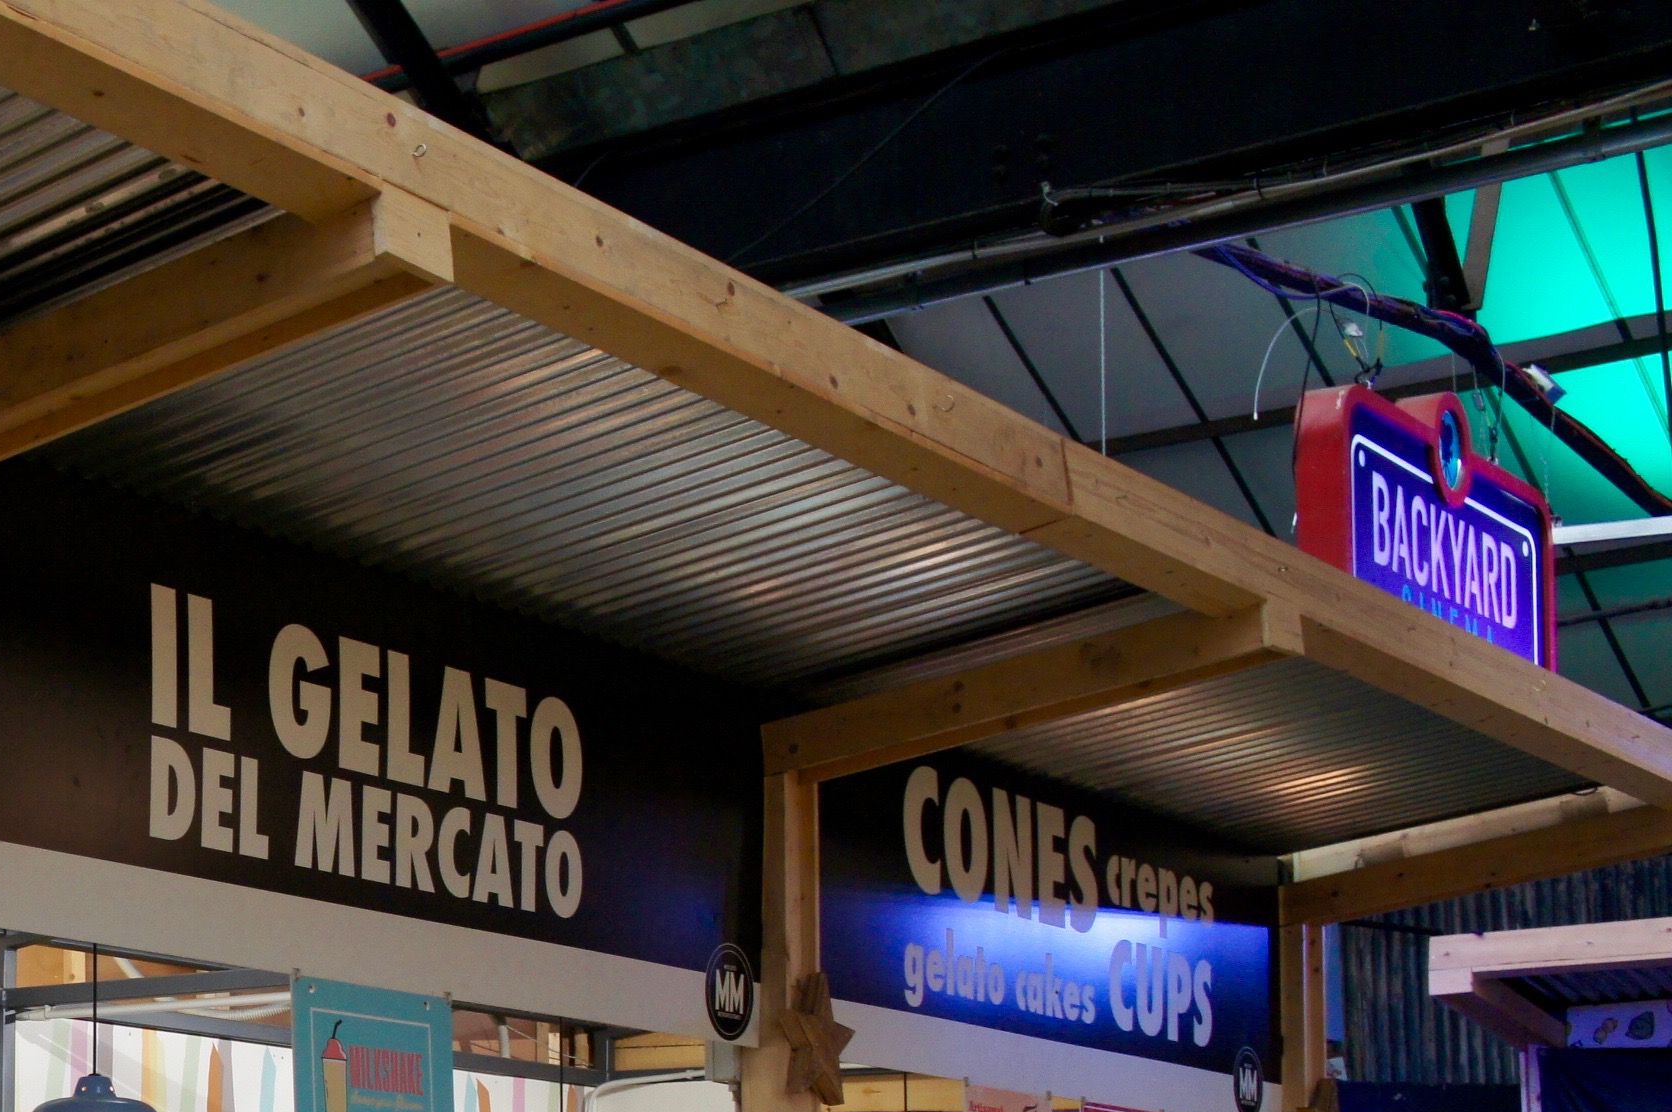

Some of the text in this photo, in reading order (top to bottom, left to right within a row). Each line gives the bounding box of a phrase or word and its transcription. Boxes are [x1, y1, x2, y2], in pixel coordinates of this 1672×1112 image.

[1372, 471, 1517, 629] BACKYARD
[151, 582, 583, 820] IL GELATO
[149, 735, 583, 918] DEL MERCATO
[903, 765, 1214, 939] CONES crepes
[715, 968, 744, 1015] MM
[904, 928, 1213, 1048] gelato cakes CUPS
